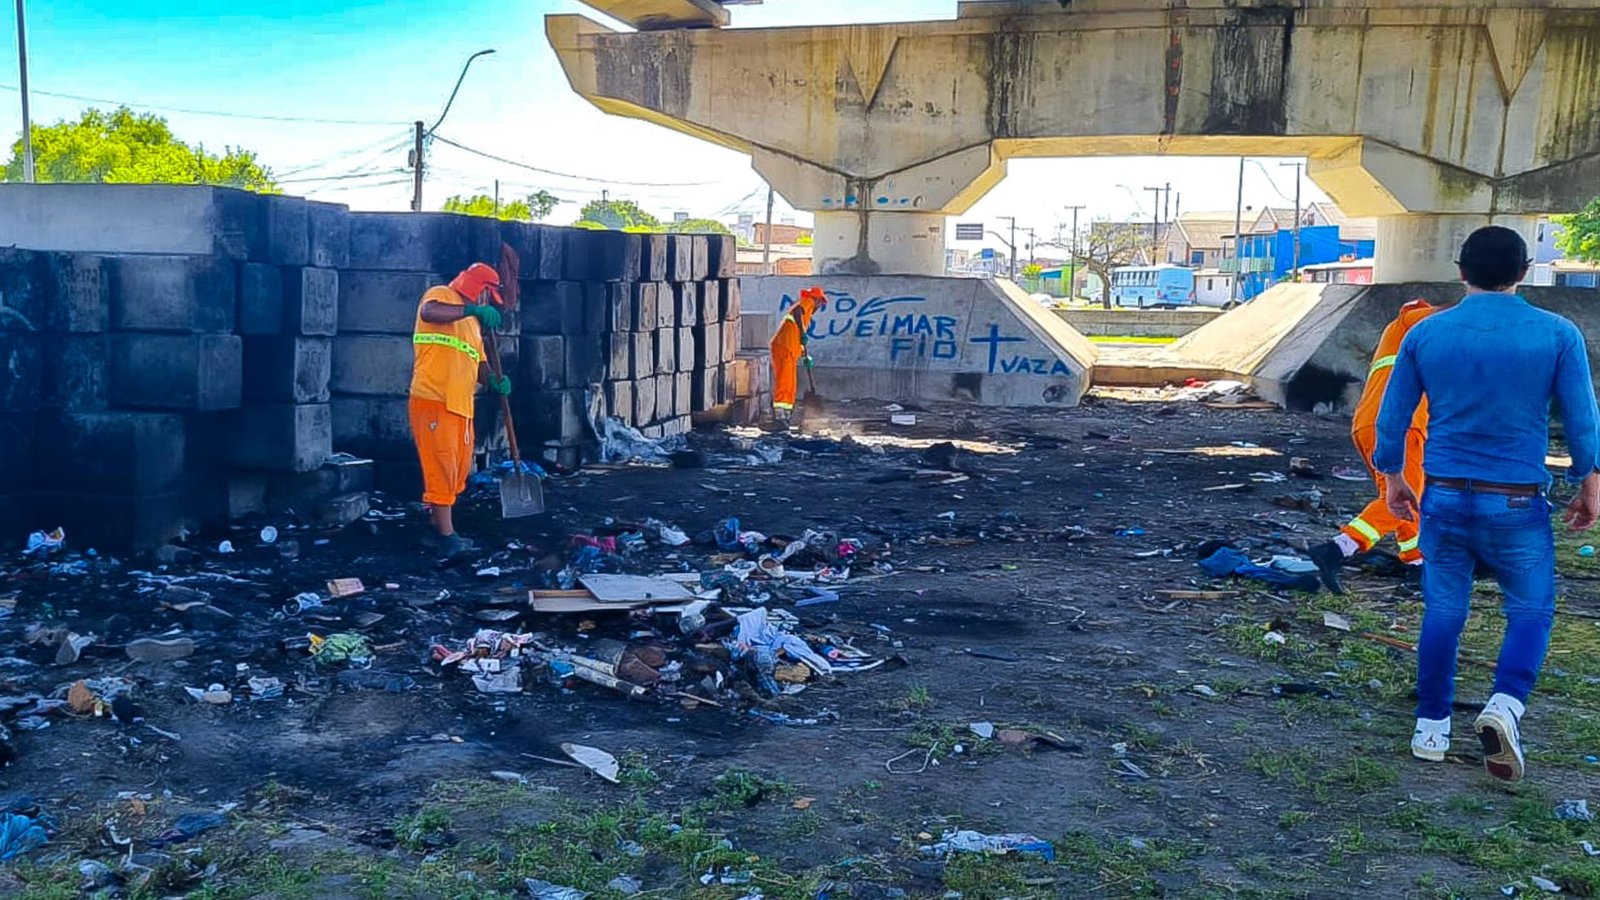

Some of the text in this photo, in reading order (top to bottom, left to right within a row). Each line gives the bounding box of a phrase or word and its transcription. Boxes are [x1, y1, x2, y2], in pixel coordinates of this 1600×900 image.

[779, 291, 857, 313] NO
[891, 333, 957, 360] FIO
[1001, 355, 1071, 376] VAZA
